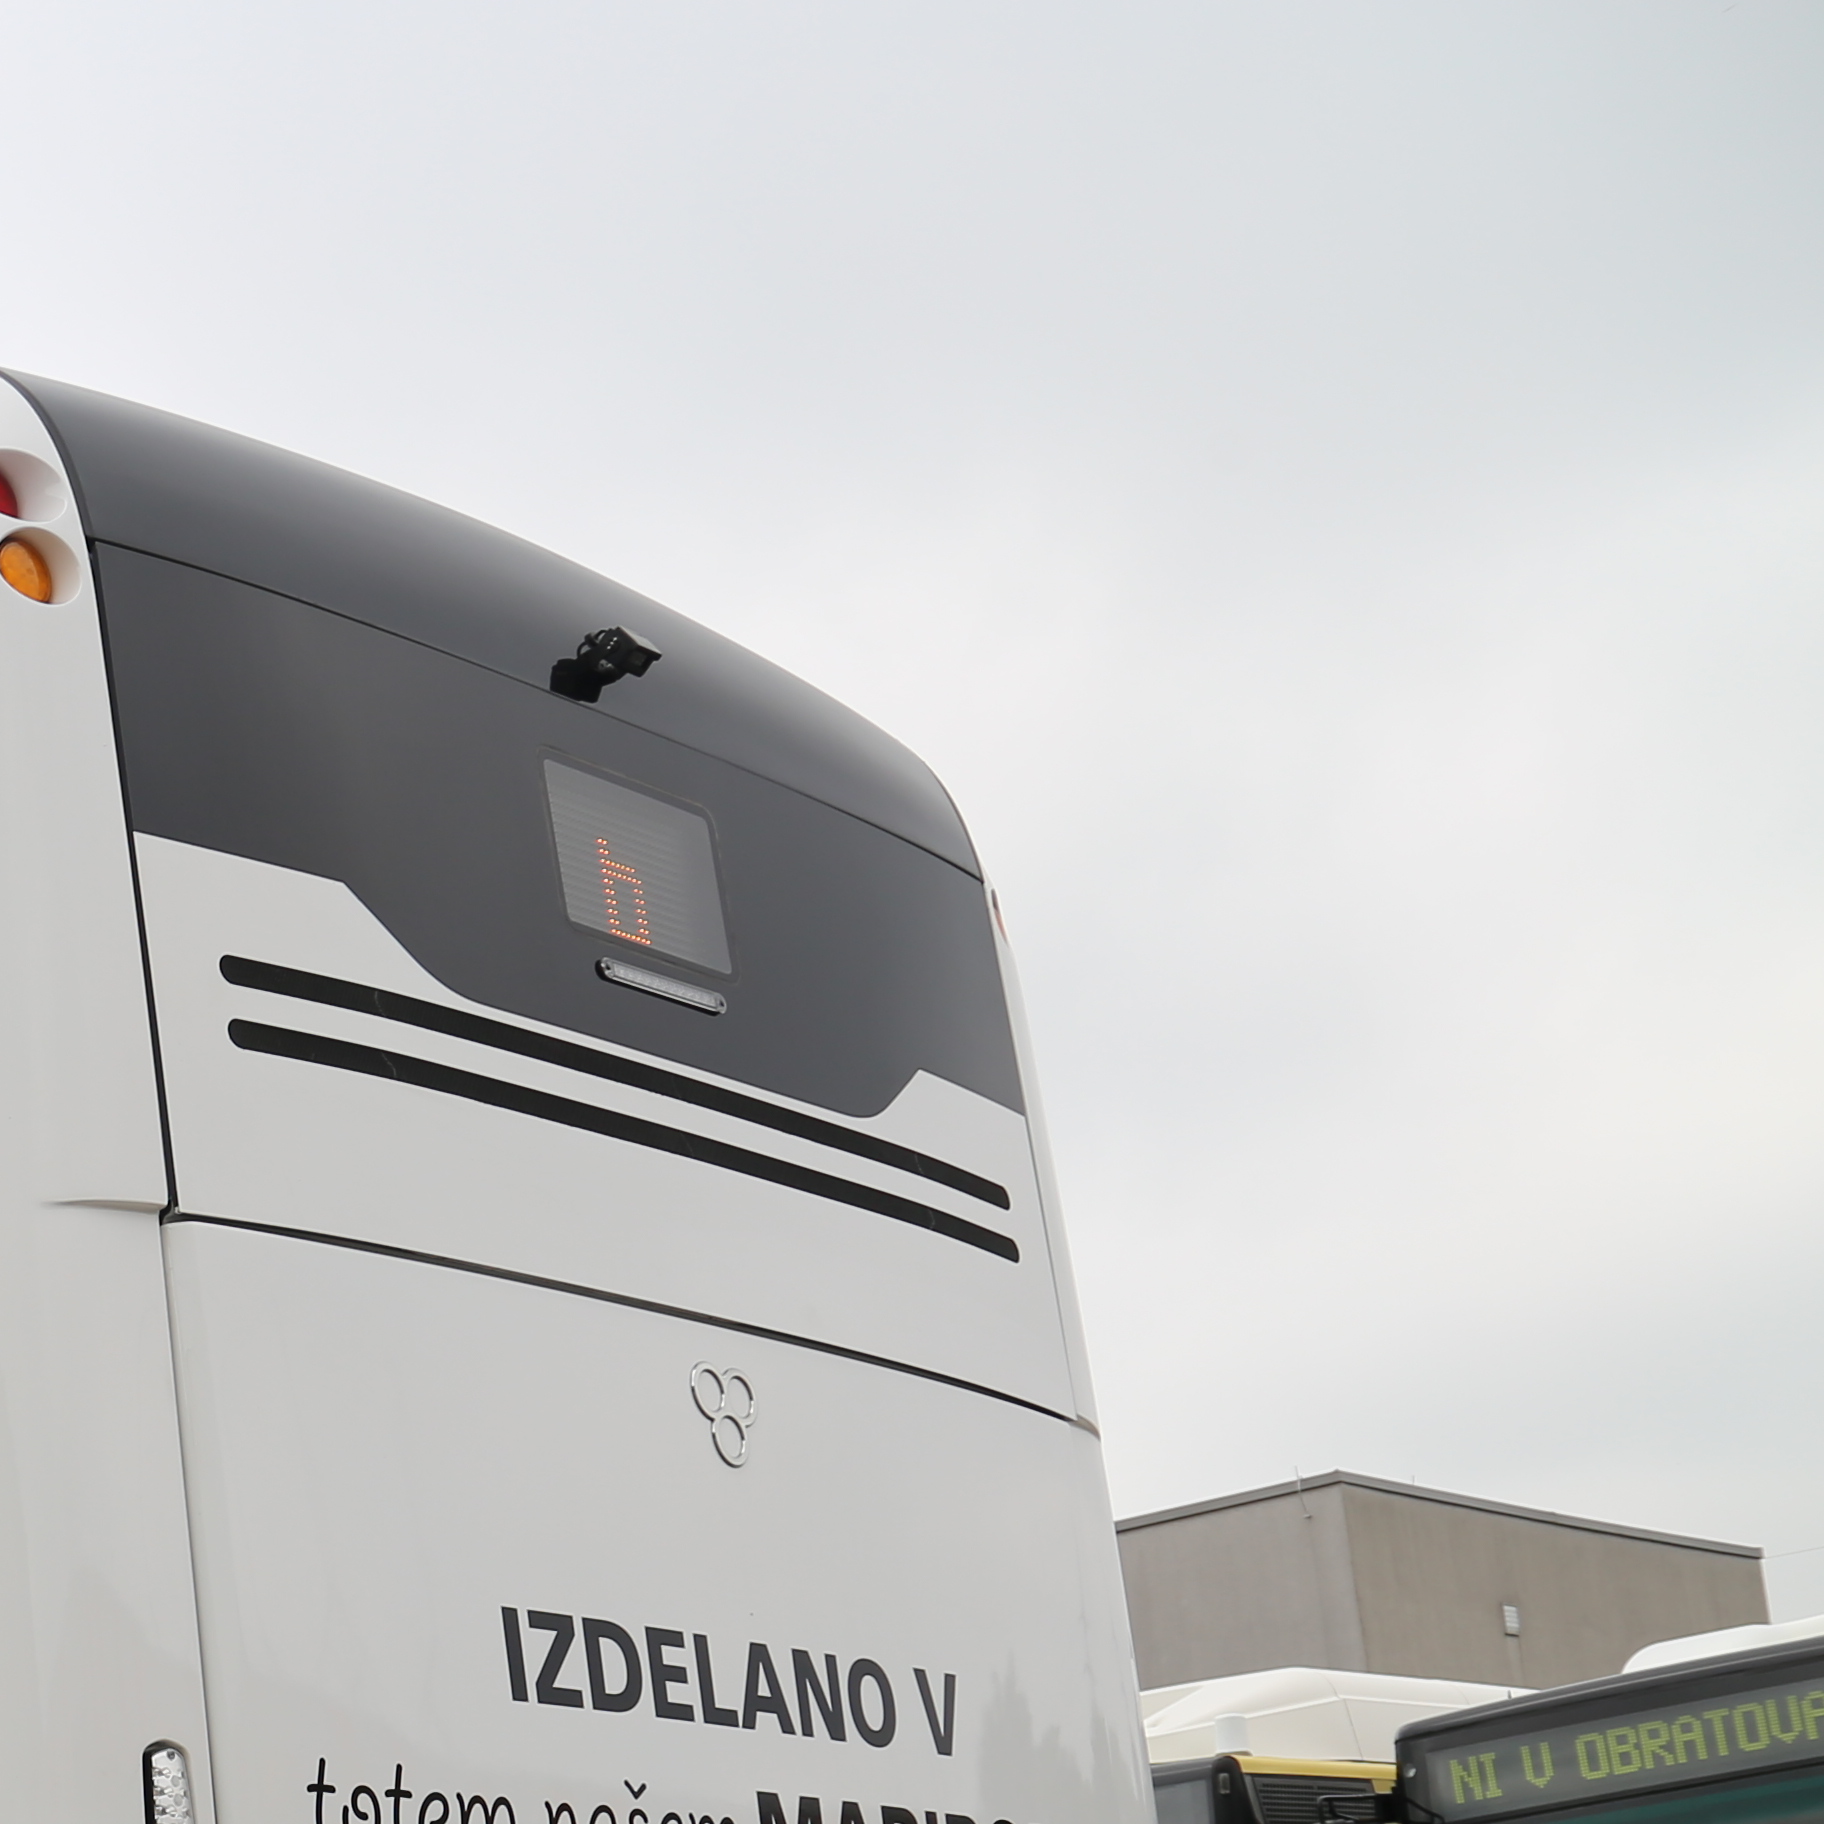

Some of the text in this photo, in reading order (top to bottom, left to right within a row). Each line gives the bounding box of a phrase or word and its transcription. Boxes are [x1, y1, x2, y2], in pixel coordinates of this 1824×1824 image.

[500, 1605, 957, 1757] IZDELANO V
[1449, 1752, 1503, 1803] NI
[1520, 1741, 1554, 1788] V
